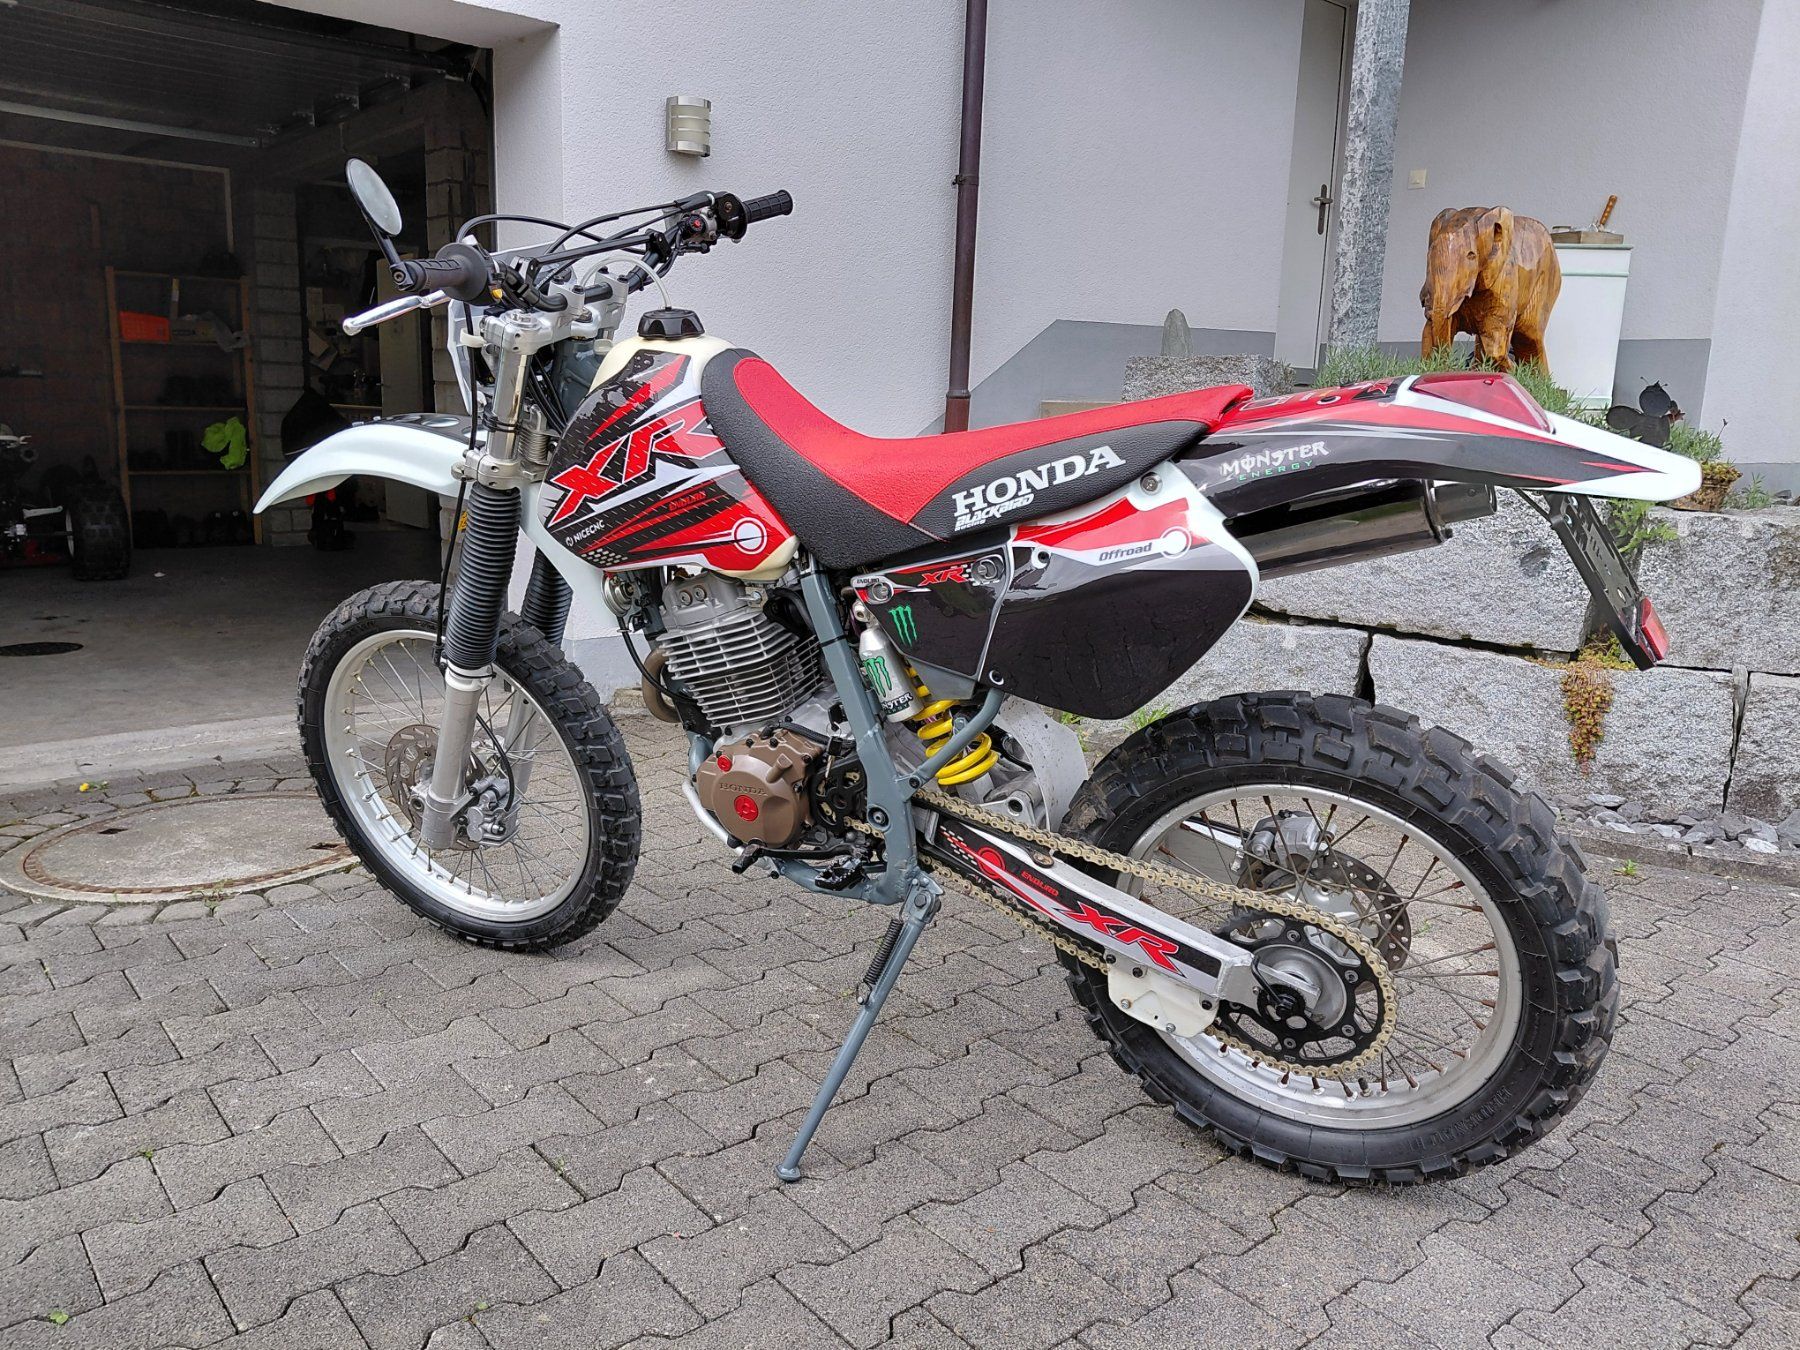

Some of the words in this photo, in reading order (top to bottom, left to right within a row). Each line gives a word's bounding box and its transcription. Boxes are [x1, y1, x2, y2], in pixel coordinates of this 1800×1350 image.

[547, 399, 726, 528] XR
[1220, 440, 1330, 476] MONSTER
[1238, 460, 1313, 481] ENERGY
[952, 445, 1126, 517] HONDA
[573, 520, 605, 543] NICECNC
[1099, 542, 1152, 561] Offroad
[918, 567, 969, 587] XR
[720, 783, 768, 797] HONDA
[1020, 870, 1060, 897] ENDURO
[1052, 901, 1187, 979] XR
